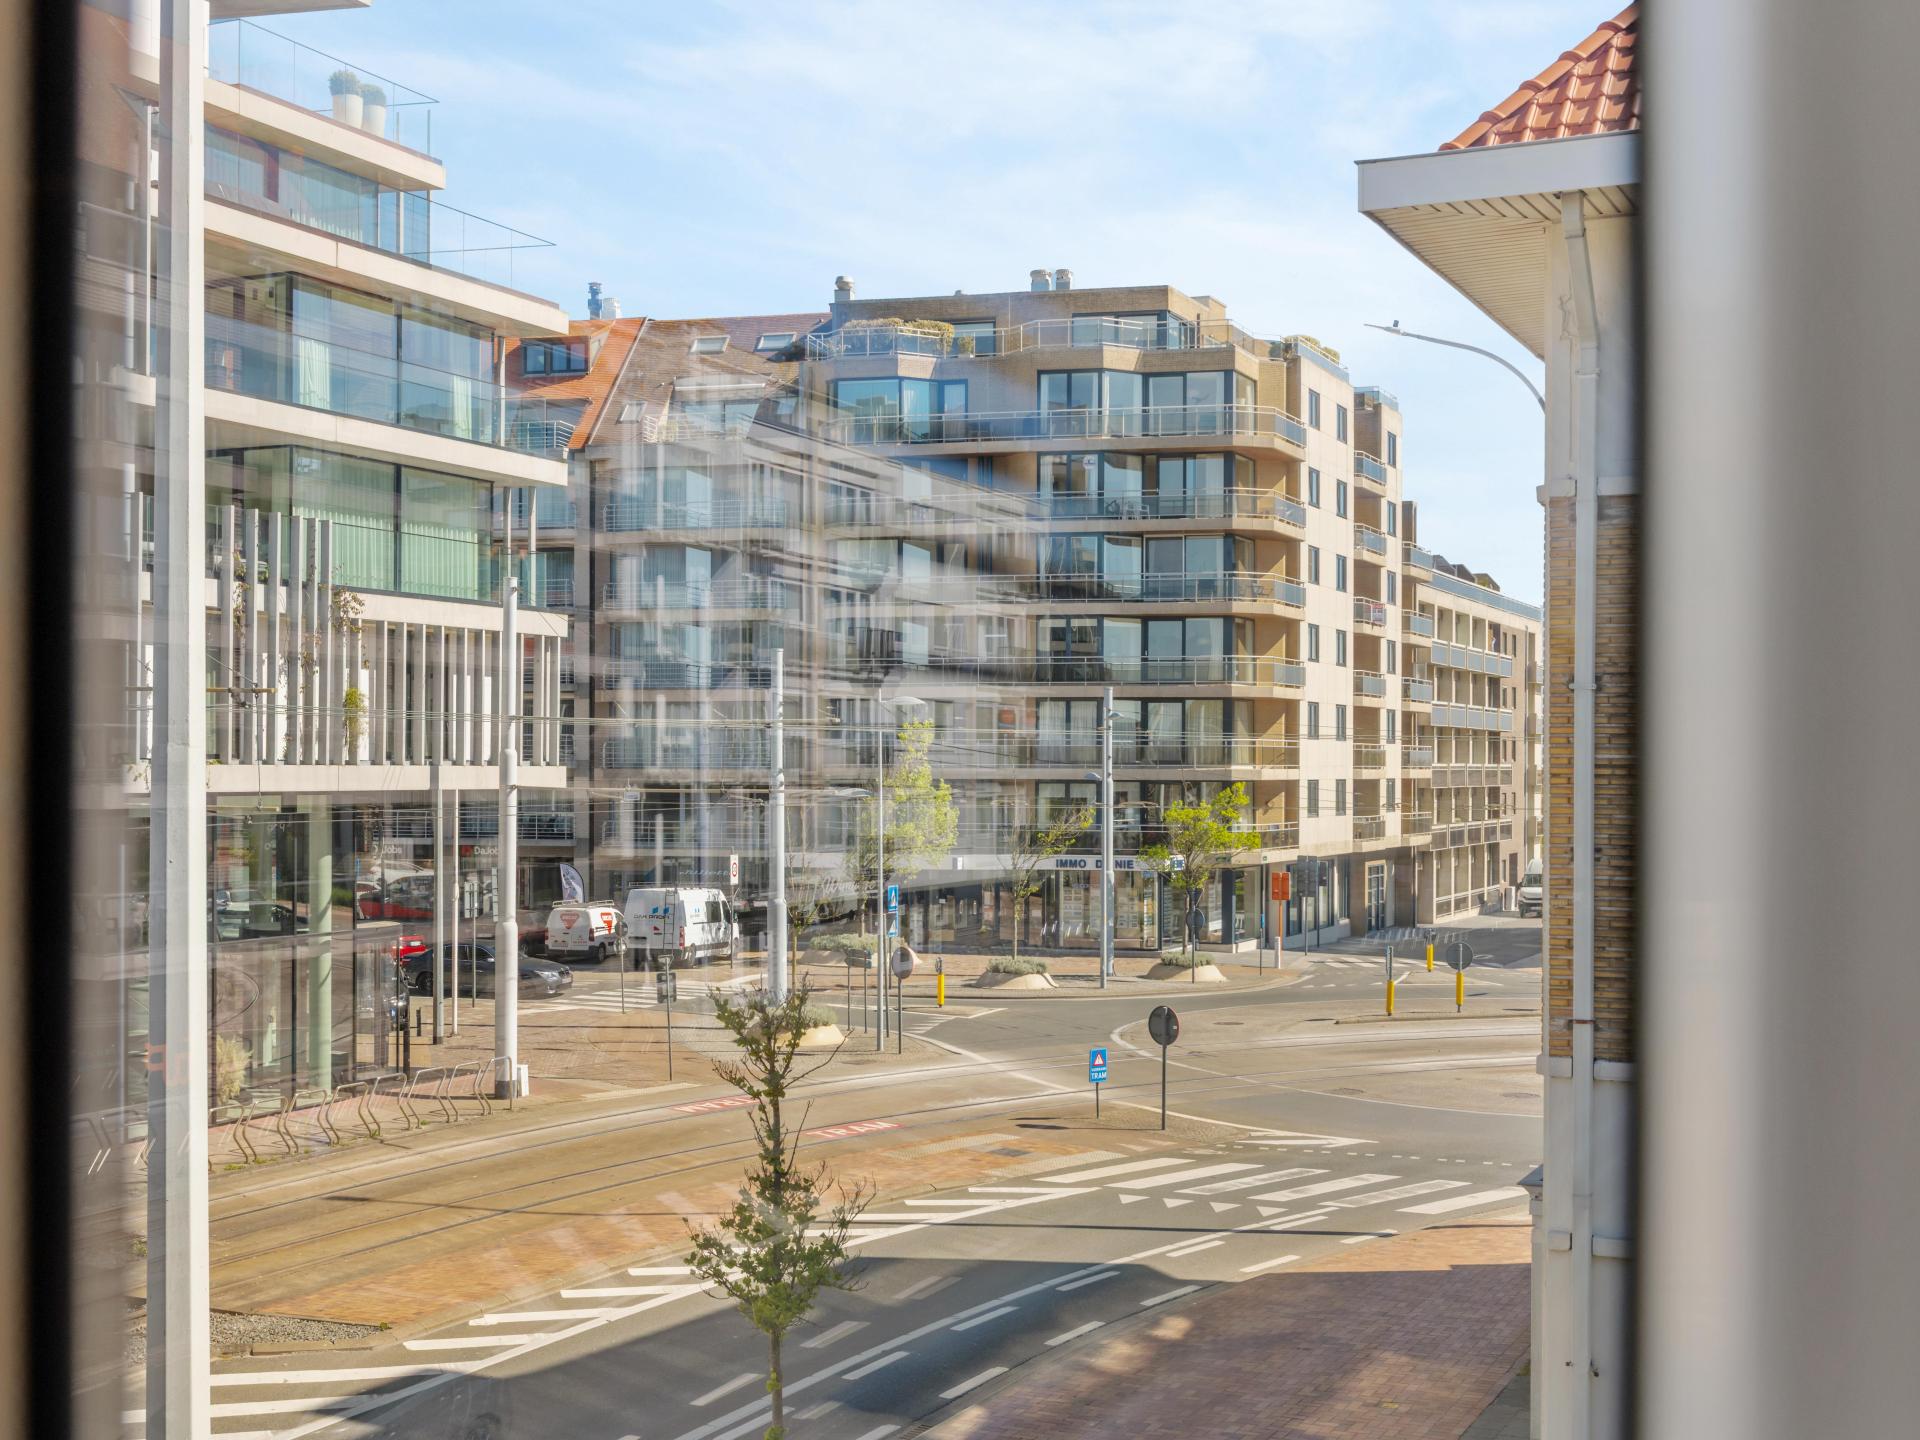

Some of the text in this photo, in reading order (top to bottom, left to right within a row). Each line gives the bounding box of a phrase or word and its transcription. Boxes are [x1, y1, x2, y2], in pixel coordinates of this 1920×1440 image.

[1056, 859, 1134, 869] IMMO DNIE
[1091, 1071, 1107, 1079] TRAM
[672, 1097, 760, 1113] TRAM
[805, 1121, 900, 1138] TRAM
